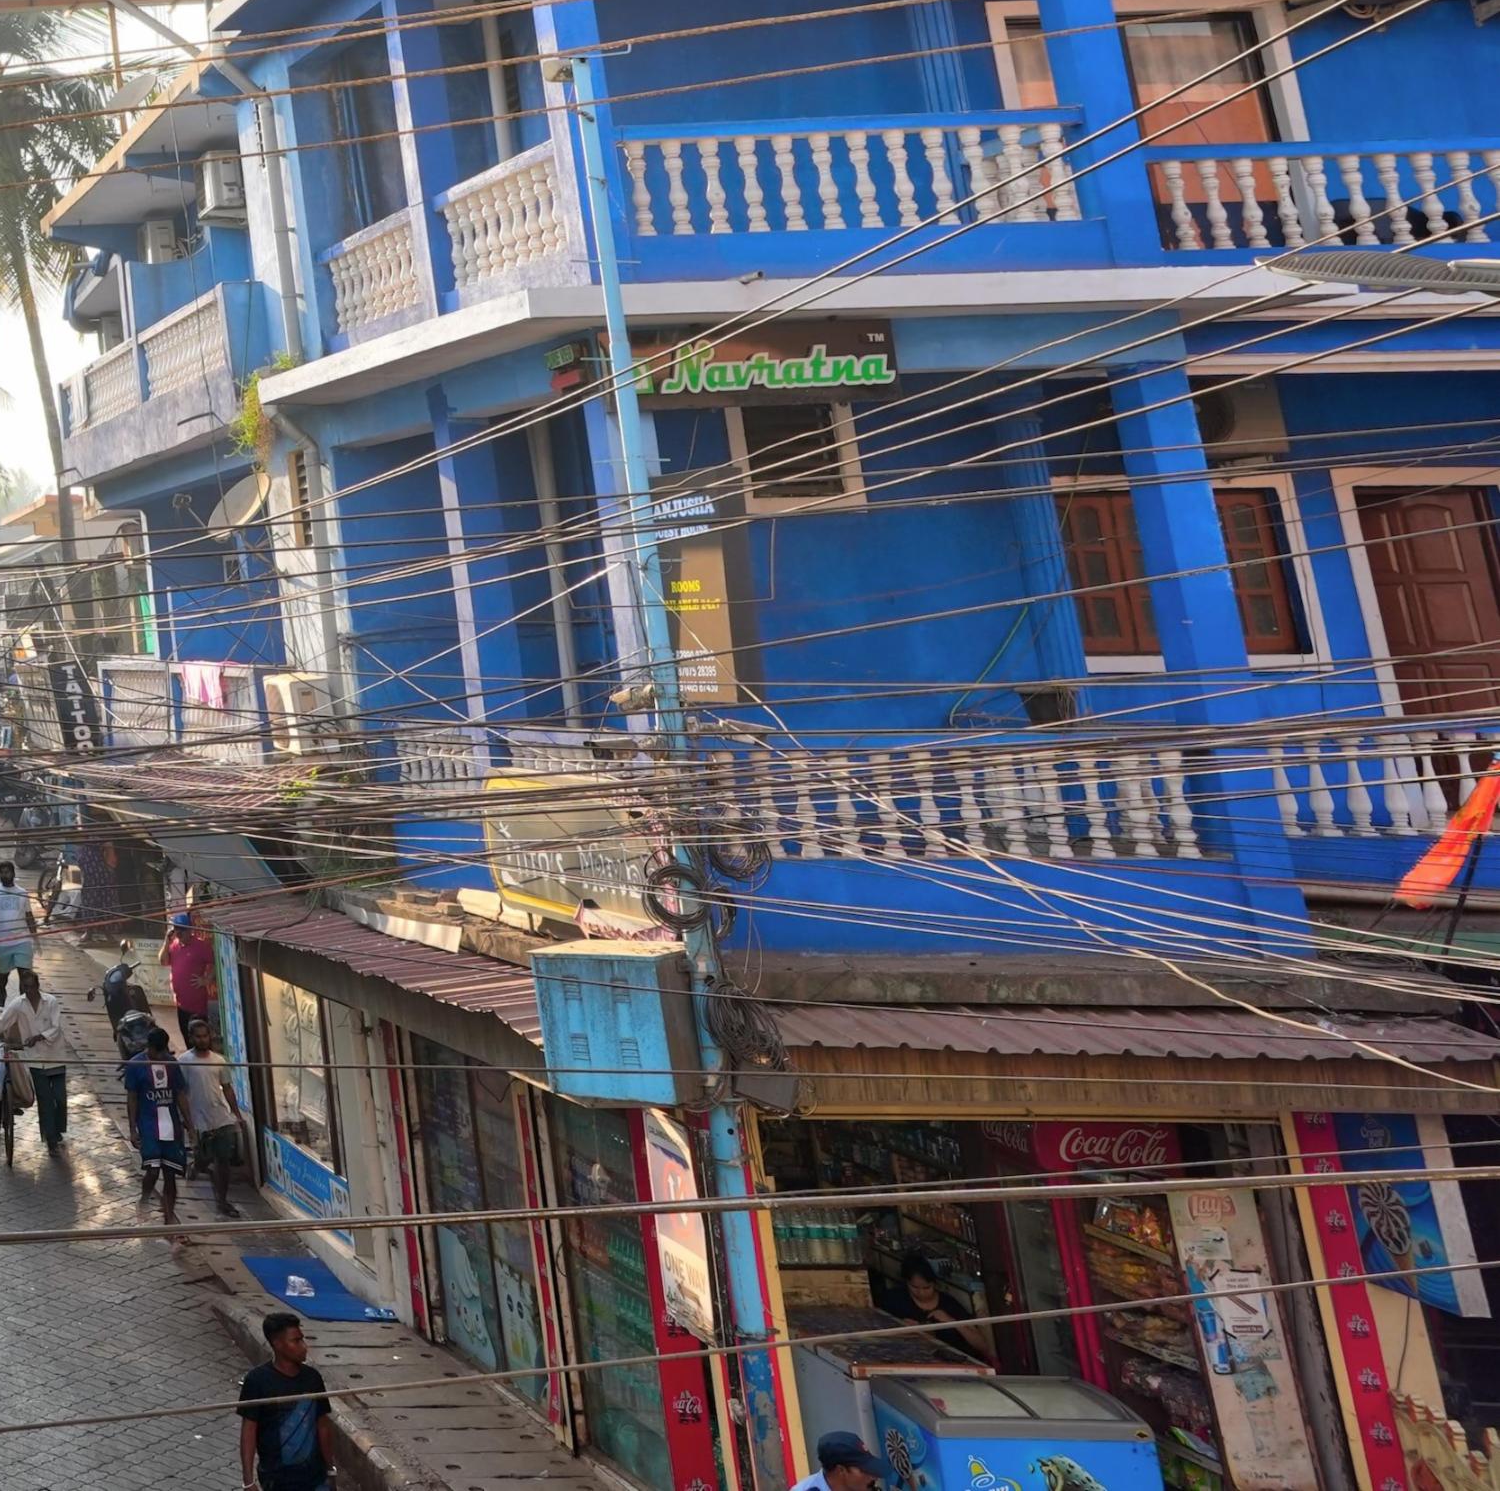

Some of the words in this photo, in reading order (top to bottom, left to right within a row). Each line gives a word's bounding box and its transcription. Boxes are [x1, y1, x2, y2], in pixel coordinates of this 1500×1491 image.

[662, 341, 896, 395] Navratna
[671, 579, 701, 593] ROOMS
[1059, 1126, 1169, 1165] Coca-Cola
